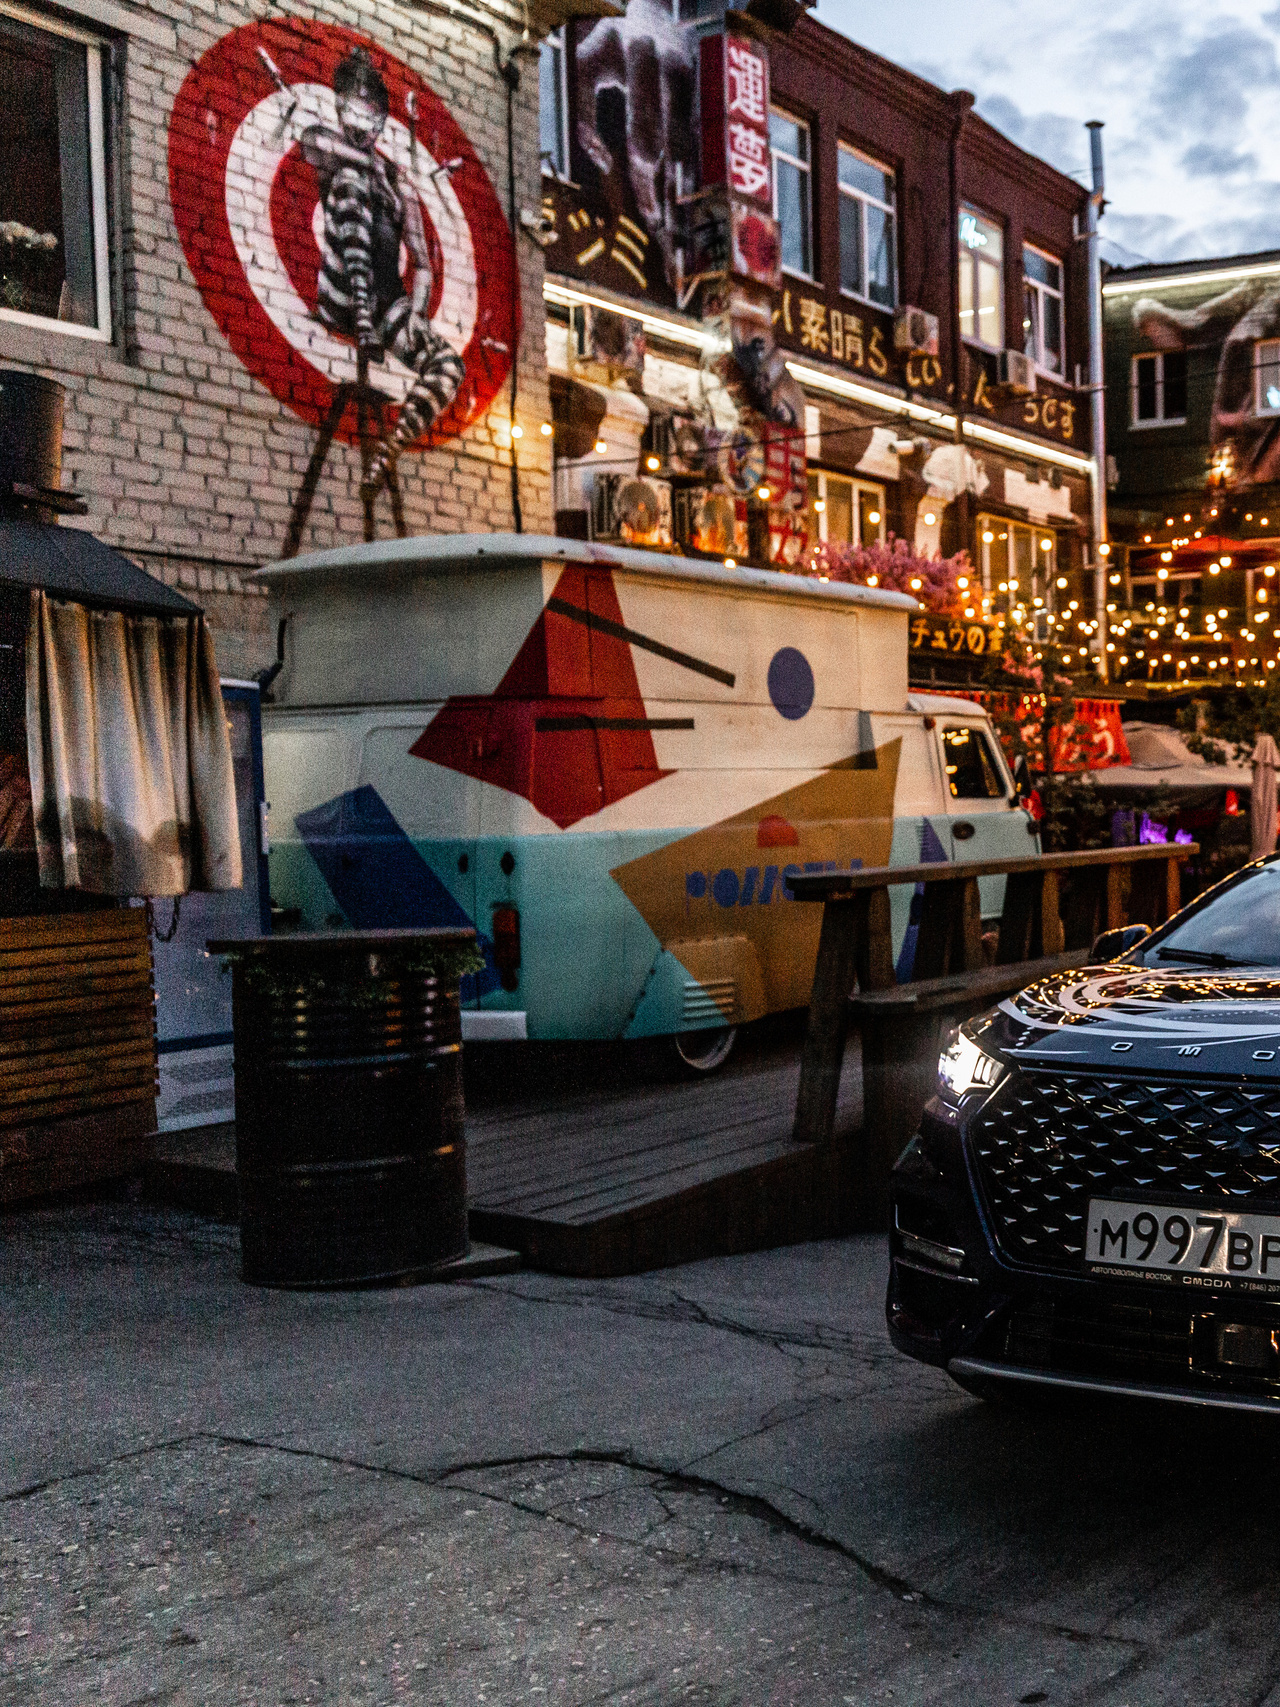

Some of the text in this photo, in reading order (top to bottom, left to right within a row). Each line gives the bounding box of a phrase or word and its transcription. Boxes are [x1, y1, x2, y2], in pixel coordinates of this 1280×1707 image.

[1145, 1271, 1172, 1281] ВОСТОК
[1182, 1276, 1232, 1288] OMODA
[1249, 1284, 1267, 1292] (846)
